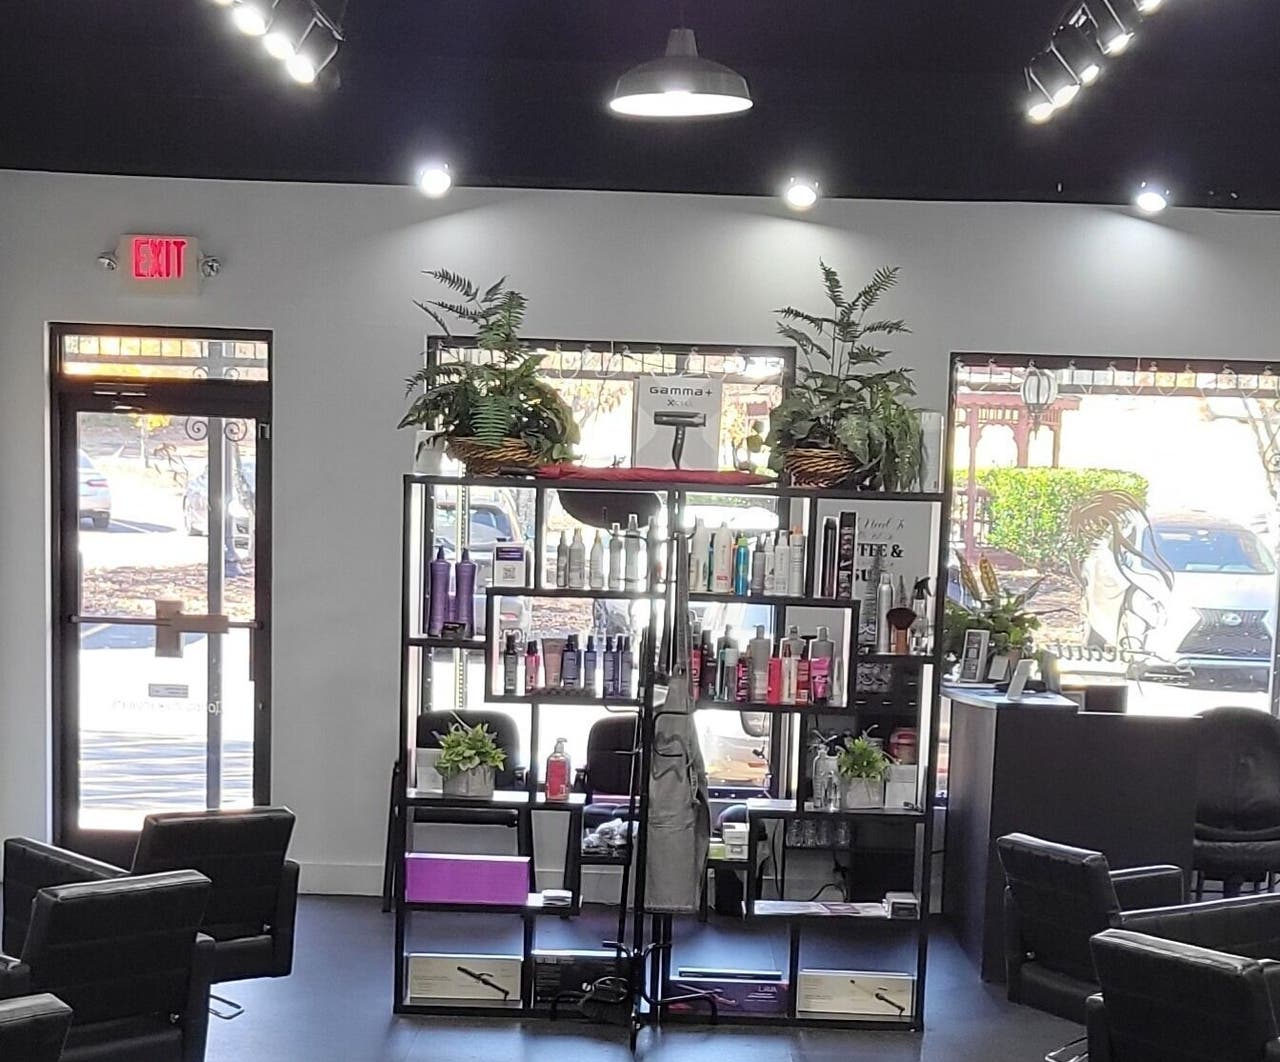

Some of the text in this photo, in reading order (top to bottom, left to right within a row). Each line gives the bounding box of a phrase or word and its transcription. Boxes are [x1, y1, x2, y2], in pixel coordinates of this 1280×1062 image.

[134, 239, 186, 278] EXIT
[649, 386, 713, 398] Gamma+
[890, 544, 904, 558] &
